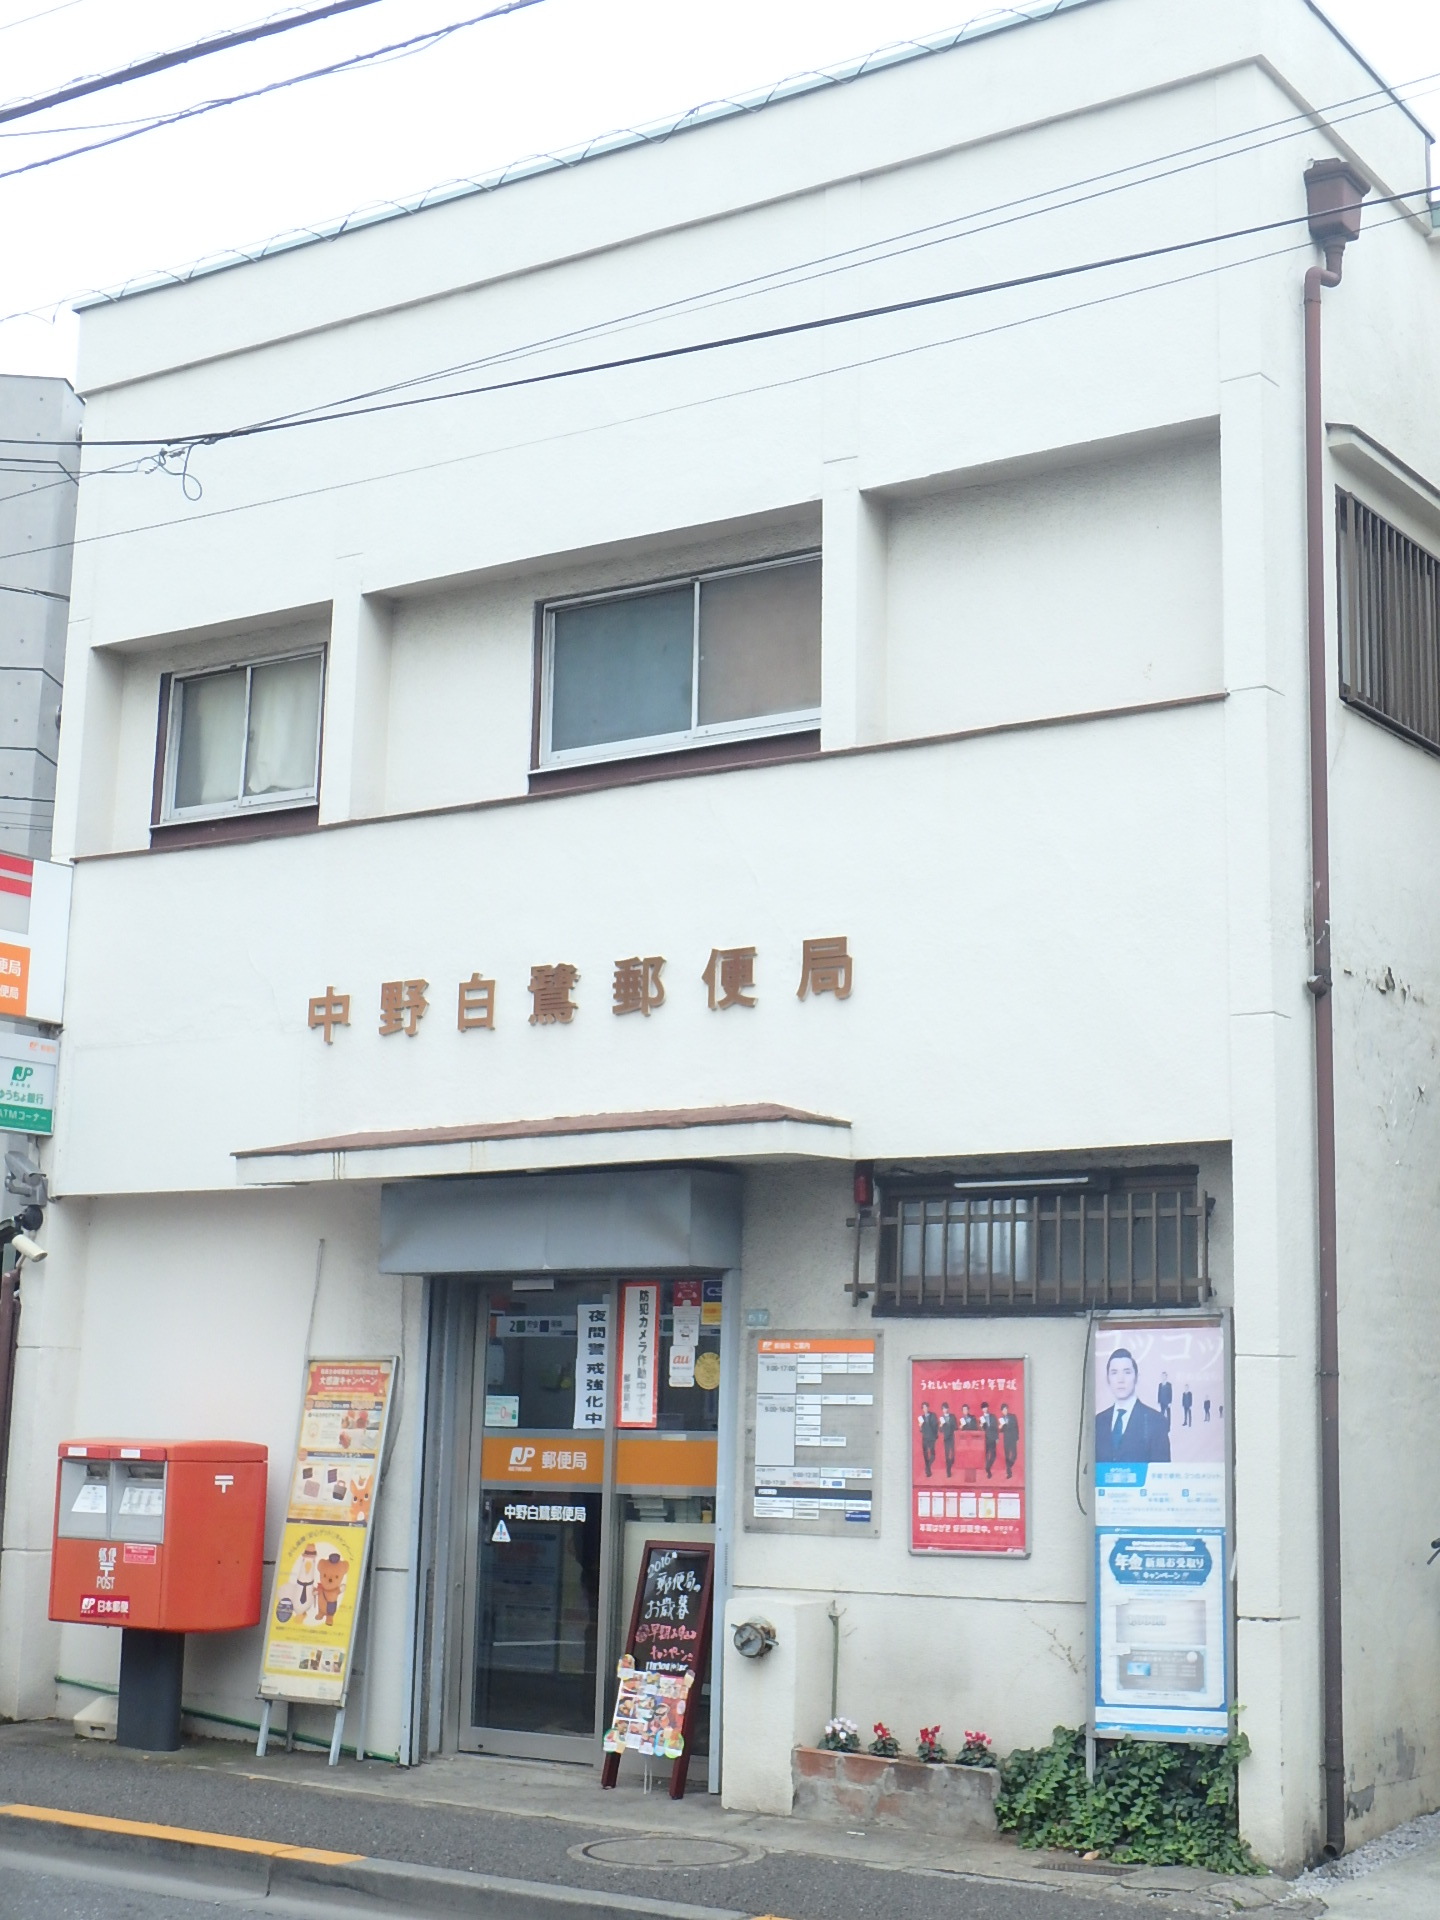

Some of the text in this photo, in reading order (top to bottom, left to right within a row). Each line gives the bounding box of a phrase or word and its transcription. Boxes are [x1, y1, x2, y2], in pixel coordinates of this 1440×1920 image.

[308, 935, 853, 1045] 中野白鷺郵便局
[636, 1289, 650, 1418] 防犯カメラ作動中です
[585, 1310, 607, 1425] 夜間警戒強化中
[541, 1451, 588, 1471] 郵便局
[504, 1504, 587, 1522] 中野白鷺郵便局
[1115, 1552, 1143, 1571] 年金
[96, 1575, 116, 1590] POST
[644, 1594, 690, 1621] お歳暮
